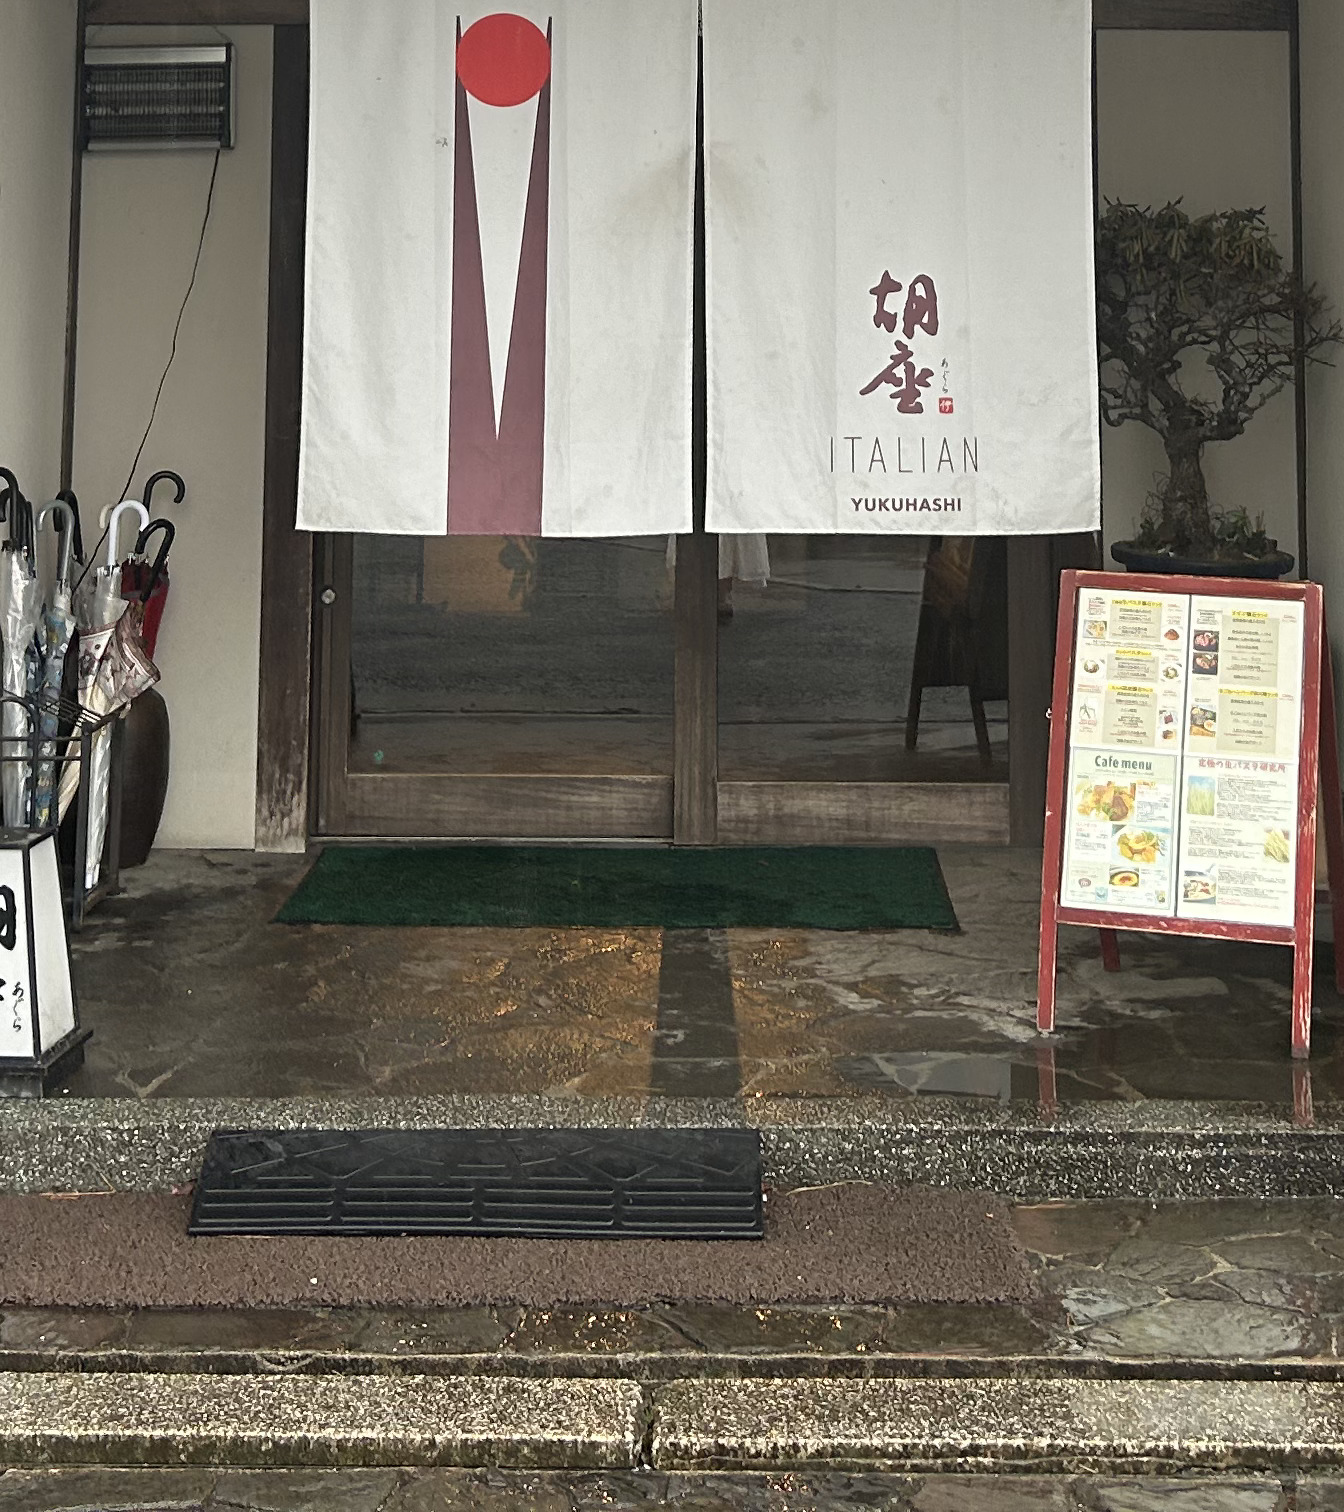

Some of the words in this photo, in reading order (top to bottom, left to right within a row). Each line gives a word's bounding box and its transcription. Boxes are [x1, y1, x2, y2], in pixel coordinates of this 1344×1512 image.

[859, 269, 939, 414] 胡座
[829, 436, 979, 474] ITALIAN
[850, 497, 962, 513] YUKUHASHI
[1094, 754, 1119, 769] Cafe
[1121, 758, 1153, 771] menu
[12, 981, 25, 1033] あぐら
